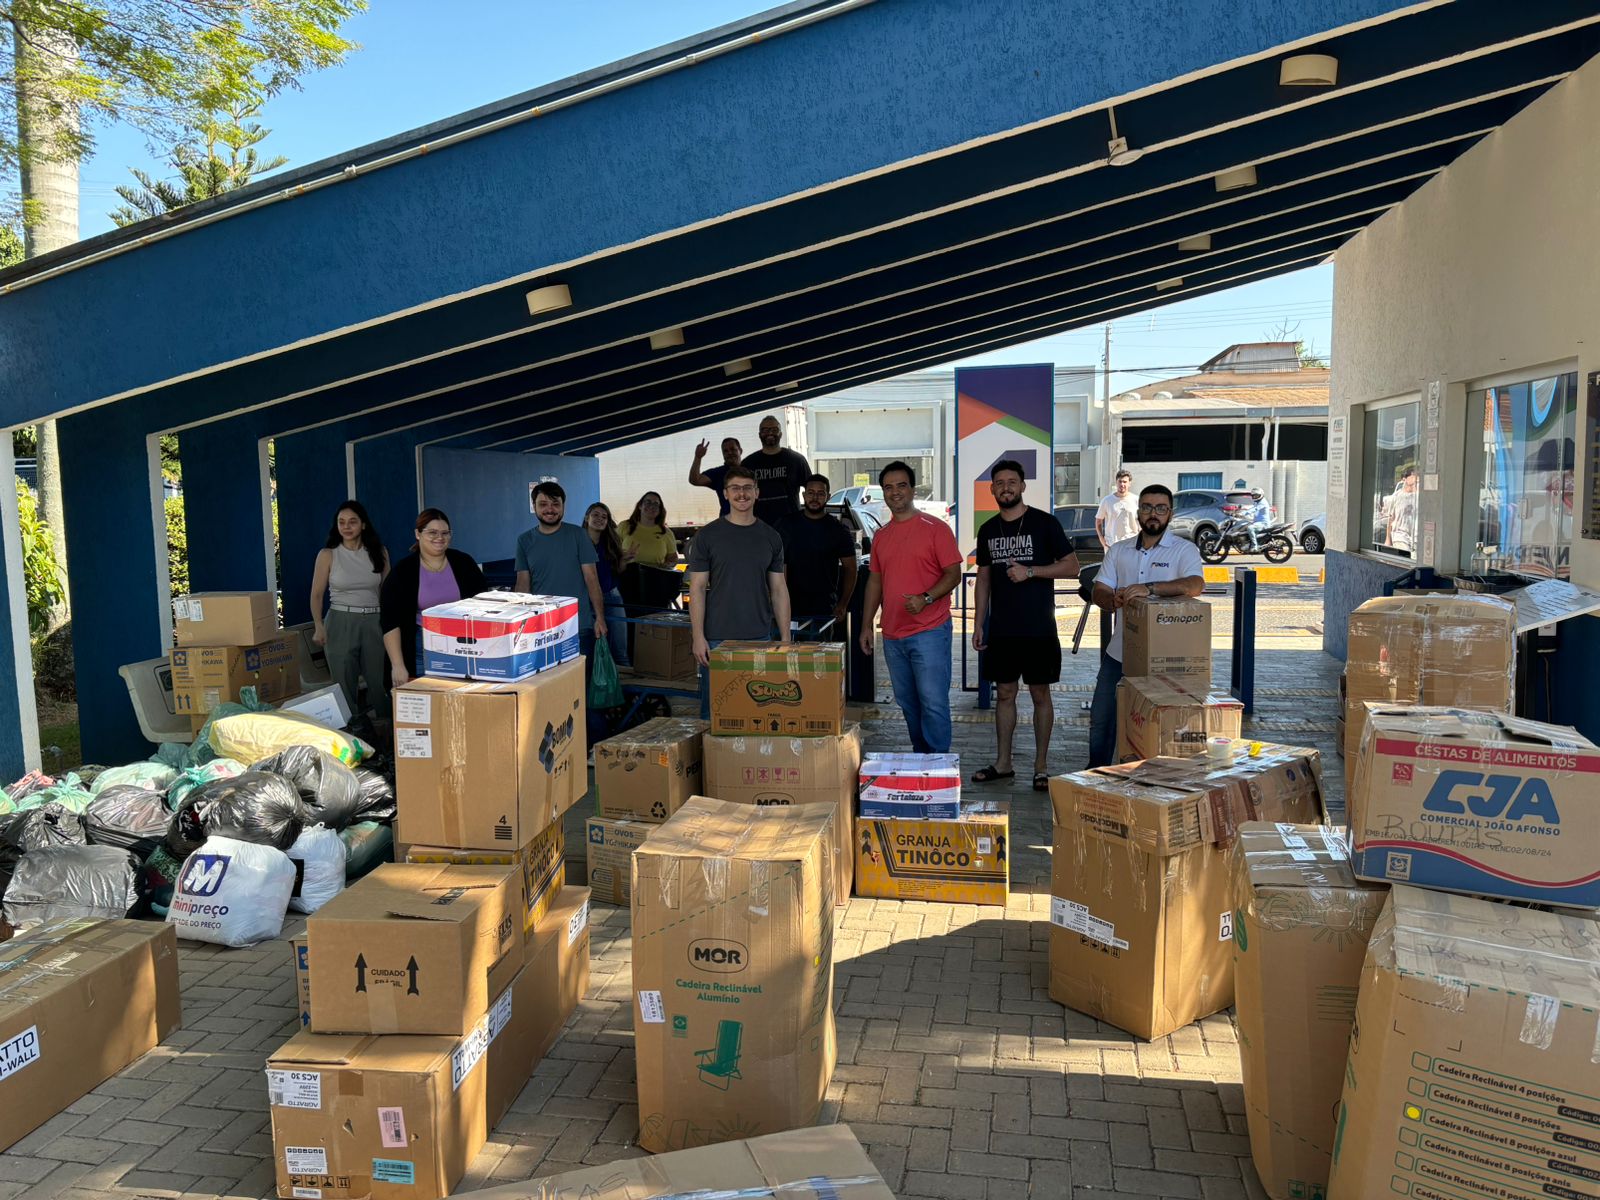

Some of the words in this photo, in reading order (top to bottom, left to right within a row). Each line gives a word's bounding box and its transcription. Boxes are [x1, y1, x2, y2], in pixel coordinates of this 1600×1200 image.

[754, 466, 787, 480] EXPLORE
[988, 535, 1033, 551] MEDICINA
[1156, 613, 1204, 624] Econopot
[1415, 744, 1468, 760] CESTAS
[1472, 750, 1491, 762] DE
[1494, 750, 1578, 768] ALIMENTOS
[1423, 769, 1561, 825] CJA
[499, 815, 507, 825] 4
[1420, 813, 1482, 828] COMERCIAL
[1484, 819, 1513, 833] JOÃO
[1516, 824, 1560, 836] AFONSO
[614, 828, 634, 839] OVOS
[896, 835, 951, 848] GRANJA
[694, 947, 741, 964] MOR
[371, 968, 406, 977] CUIDADO
[676, 979, 711, 990] Cadeira
[713, 982, 763, 994] Reclinável
[697, 993, 741, 1004] Alumínio
[291, 1072, 301, 1080] 30
[302, 1073, 319, 1081] ACS
[1438, 1064, 1470, 1080] Cadeira
[1471, 1073, 1517, 1092] Reclinável
[1519, 1086, 1525, 1094] 4
[1526, 1089, 1566, 1105] posições
[1433, 1089, 1467, 1105] Cadeira
[1467, 1098, 1513, 1119] Reclinável
[1514, 1112, 1521, 1120] 8
[1521, 1115, 1561, 1131] posições
[1429, 1115, 1461, 1131] Cadeira
[1462, 1124, 1508, 1145] Reclinável
[1509, 1138, 1516, 1146] 8
[1517, 1141, 1557, 1158] posições
[1557, 1152, 1577, 1163] azul
[1425, 1140, 1457, 1156] Cadeira
[1458, 1150, 1503, 1169] Reclinável
[1504, 1163, 1511, 1171] 8
[1511, 1166, 1550, 1183] posições
[1552, 1178, 1572, 1188] anis
[1420, 1164, 1452, 1180] Cadeira
[1453, 1175, 1498, 1195] Reclinável
[1500, 1189, 1506, 1197] 8
